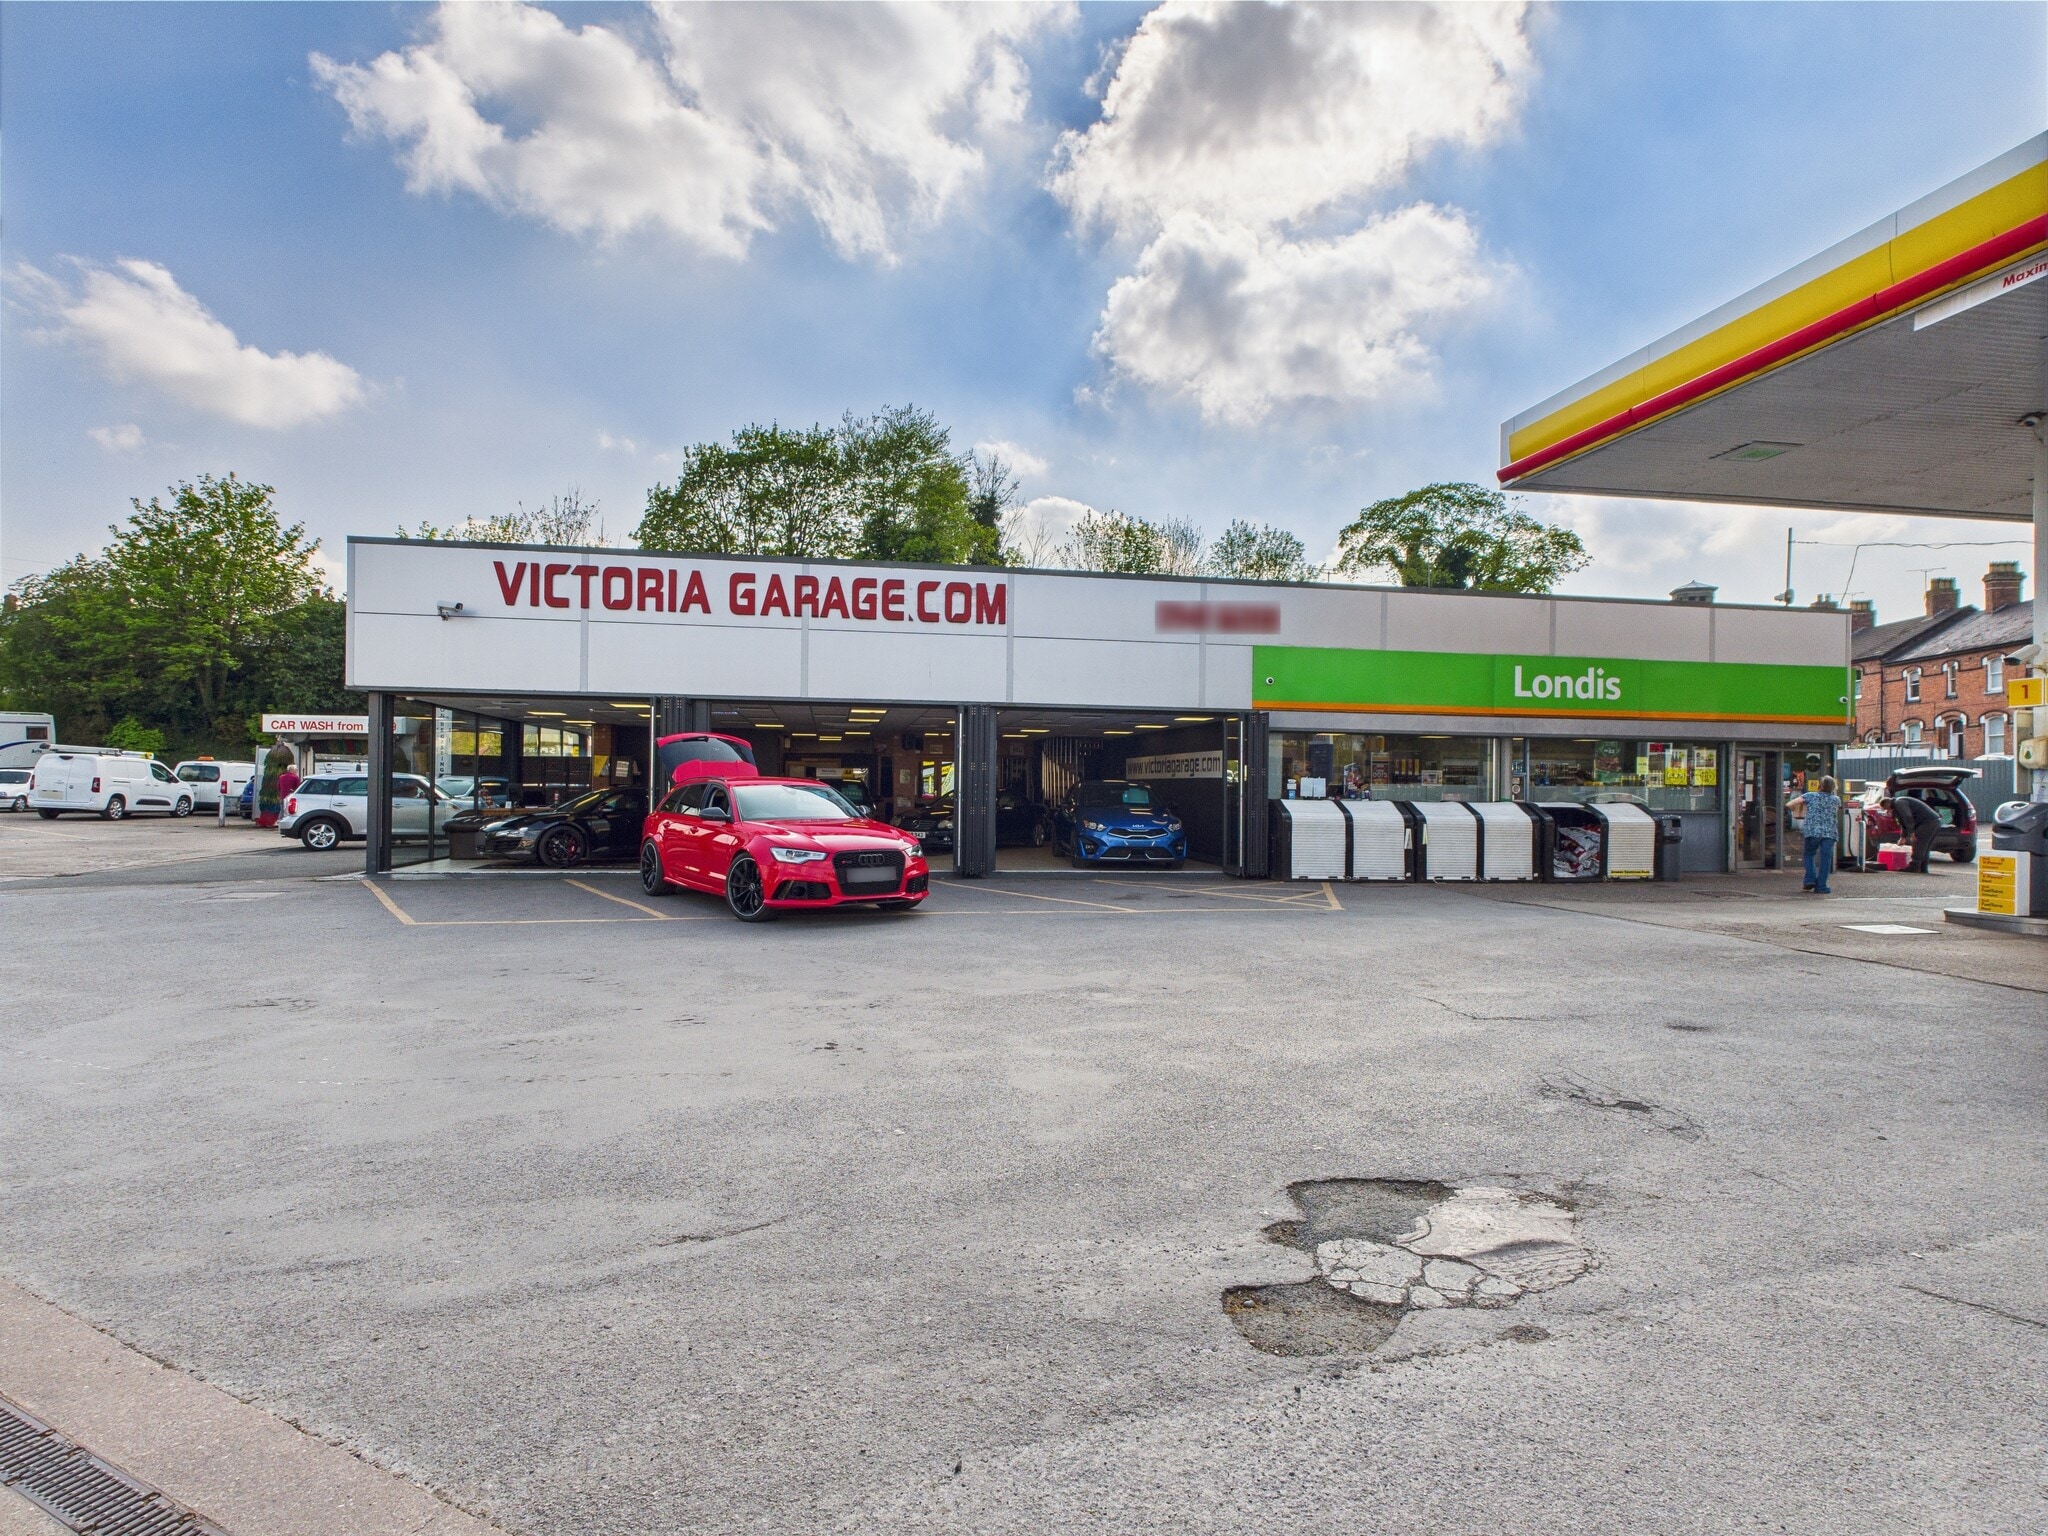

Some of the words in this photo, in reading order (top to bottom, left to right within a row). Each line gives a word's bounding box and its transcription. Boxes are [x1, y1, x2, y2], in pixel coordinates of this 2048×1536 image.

[493, 561, 712, 614] VICTORIA
[729, 572, 1006, 625] GARAGE.COM
[1514, 665, 1621, 700] Londis
[2022, 684, 2029, 699] 1
[271, 720, 296, 730] CAR
[300, 720, 334, 731] WASH
[338, 721, 364, 731] from
[1127, 757, 1221, 776] www.victoriagarage.com
